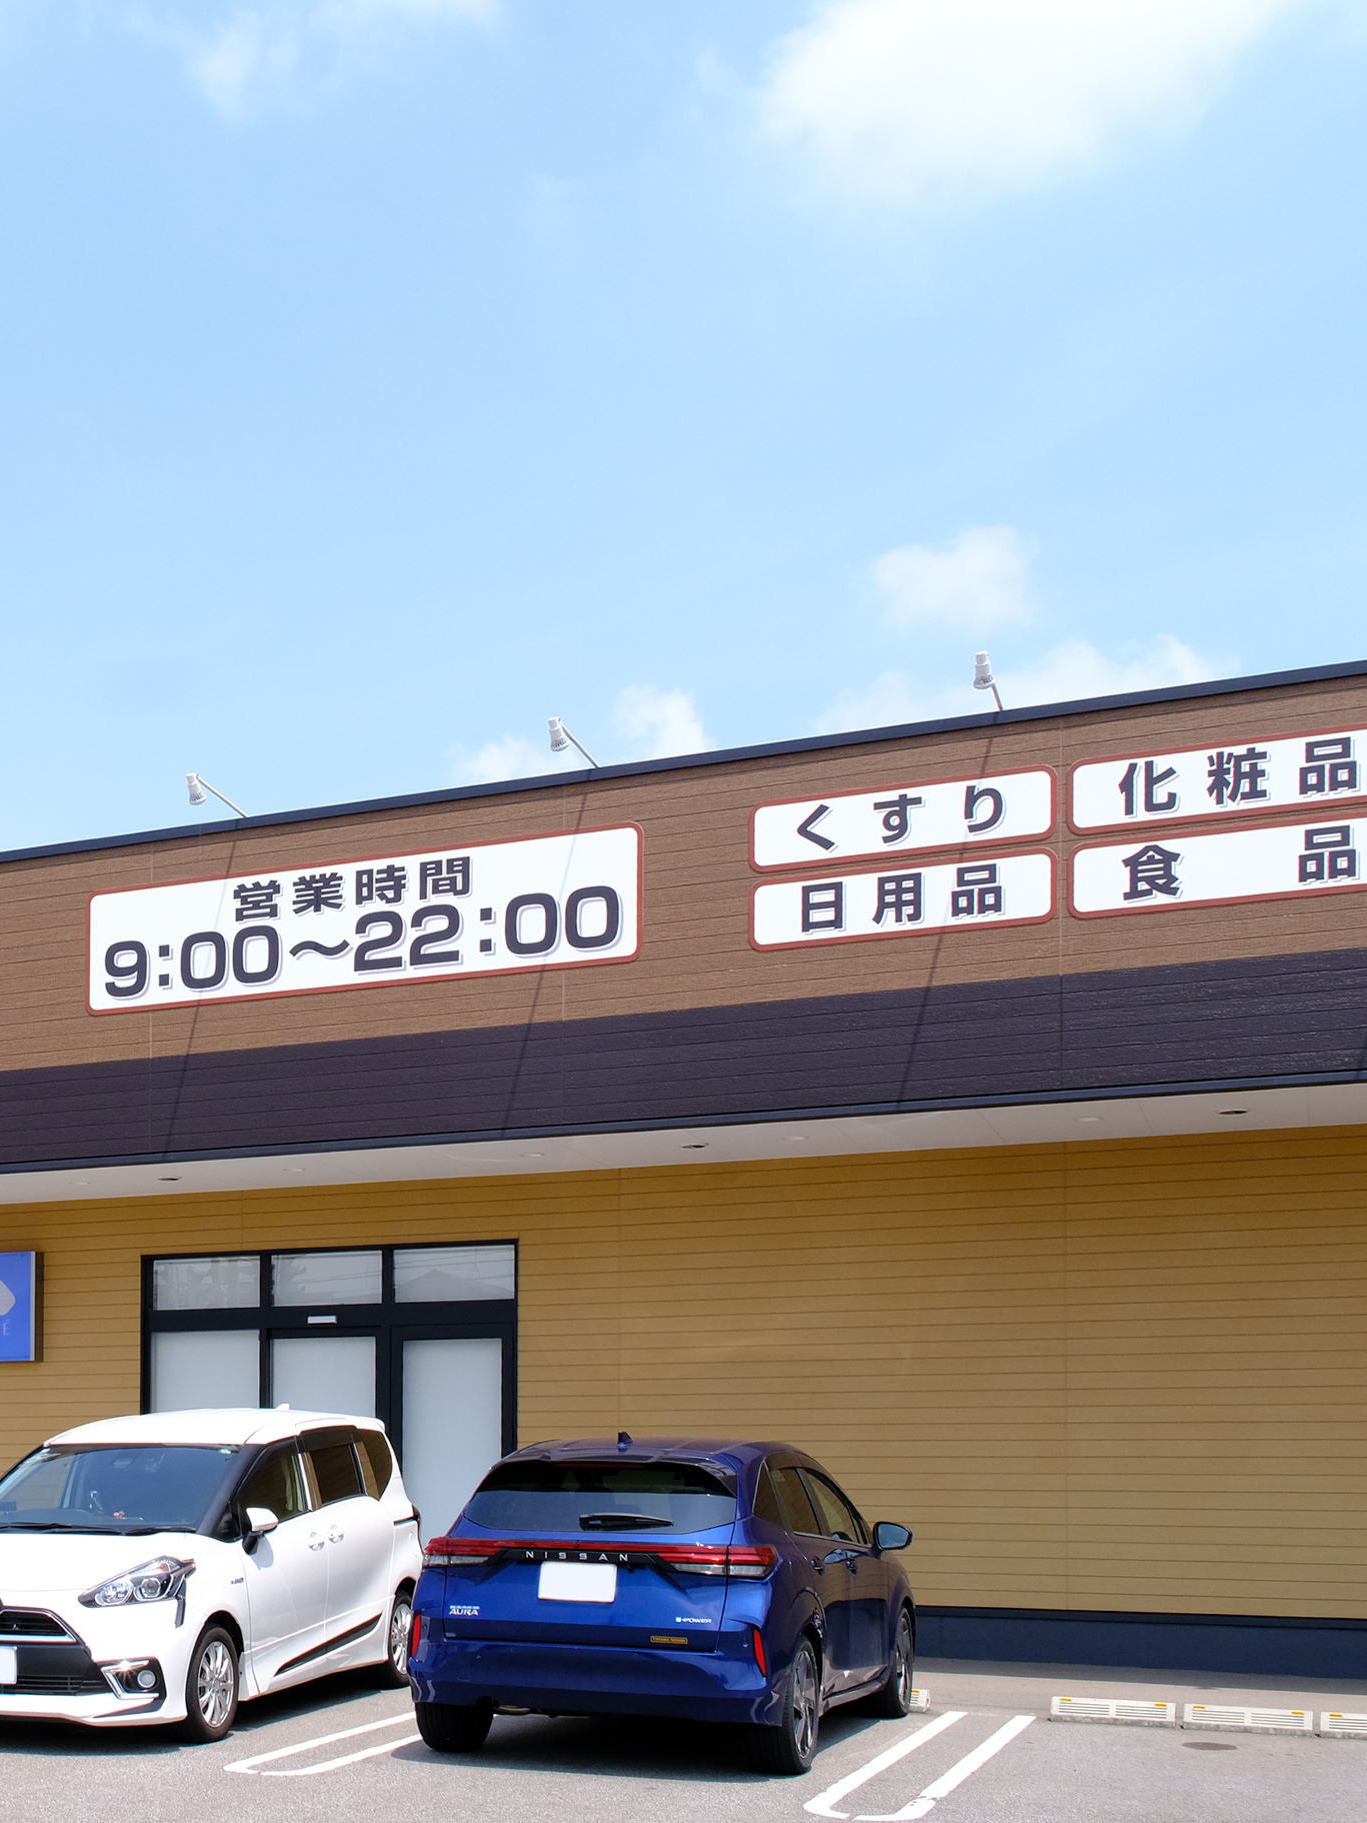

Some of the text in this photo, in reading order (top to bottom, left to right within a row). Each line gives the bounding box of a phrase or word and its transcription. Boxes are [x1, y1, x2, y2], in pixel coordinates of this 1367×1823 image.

[1118, 737, 1358, 816] 化粧品
[796, 785, 1004, 851] くすり
[233, 856, 472, 922] 営業時間
[800, 863, 1003, 933] 日用品
[525, 1550, 630, 1562] NISSAN
[448, 1608, 479, 1617] AURA
